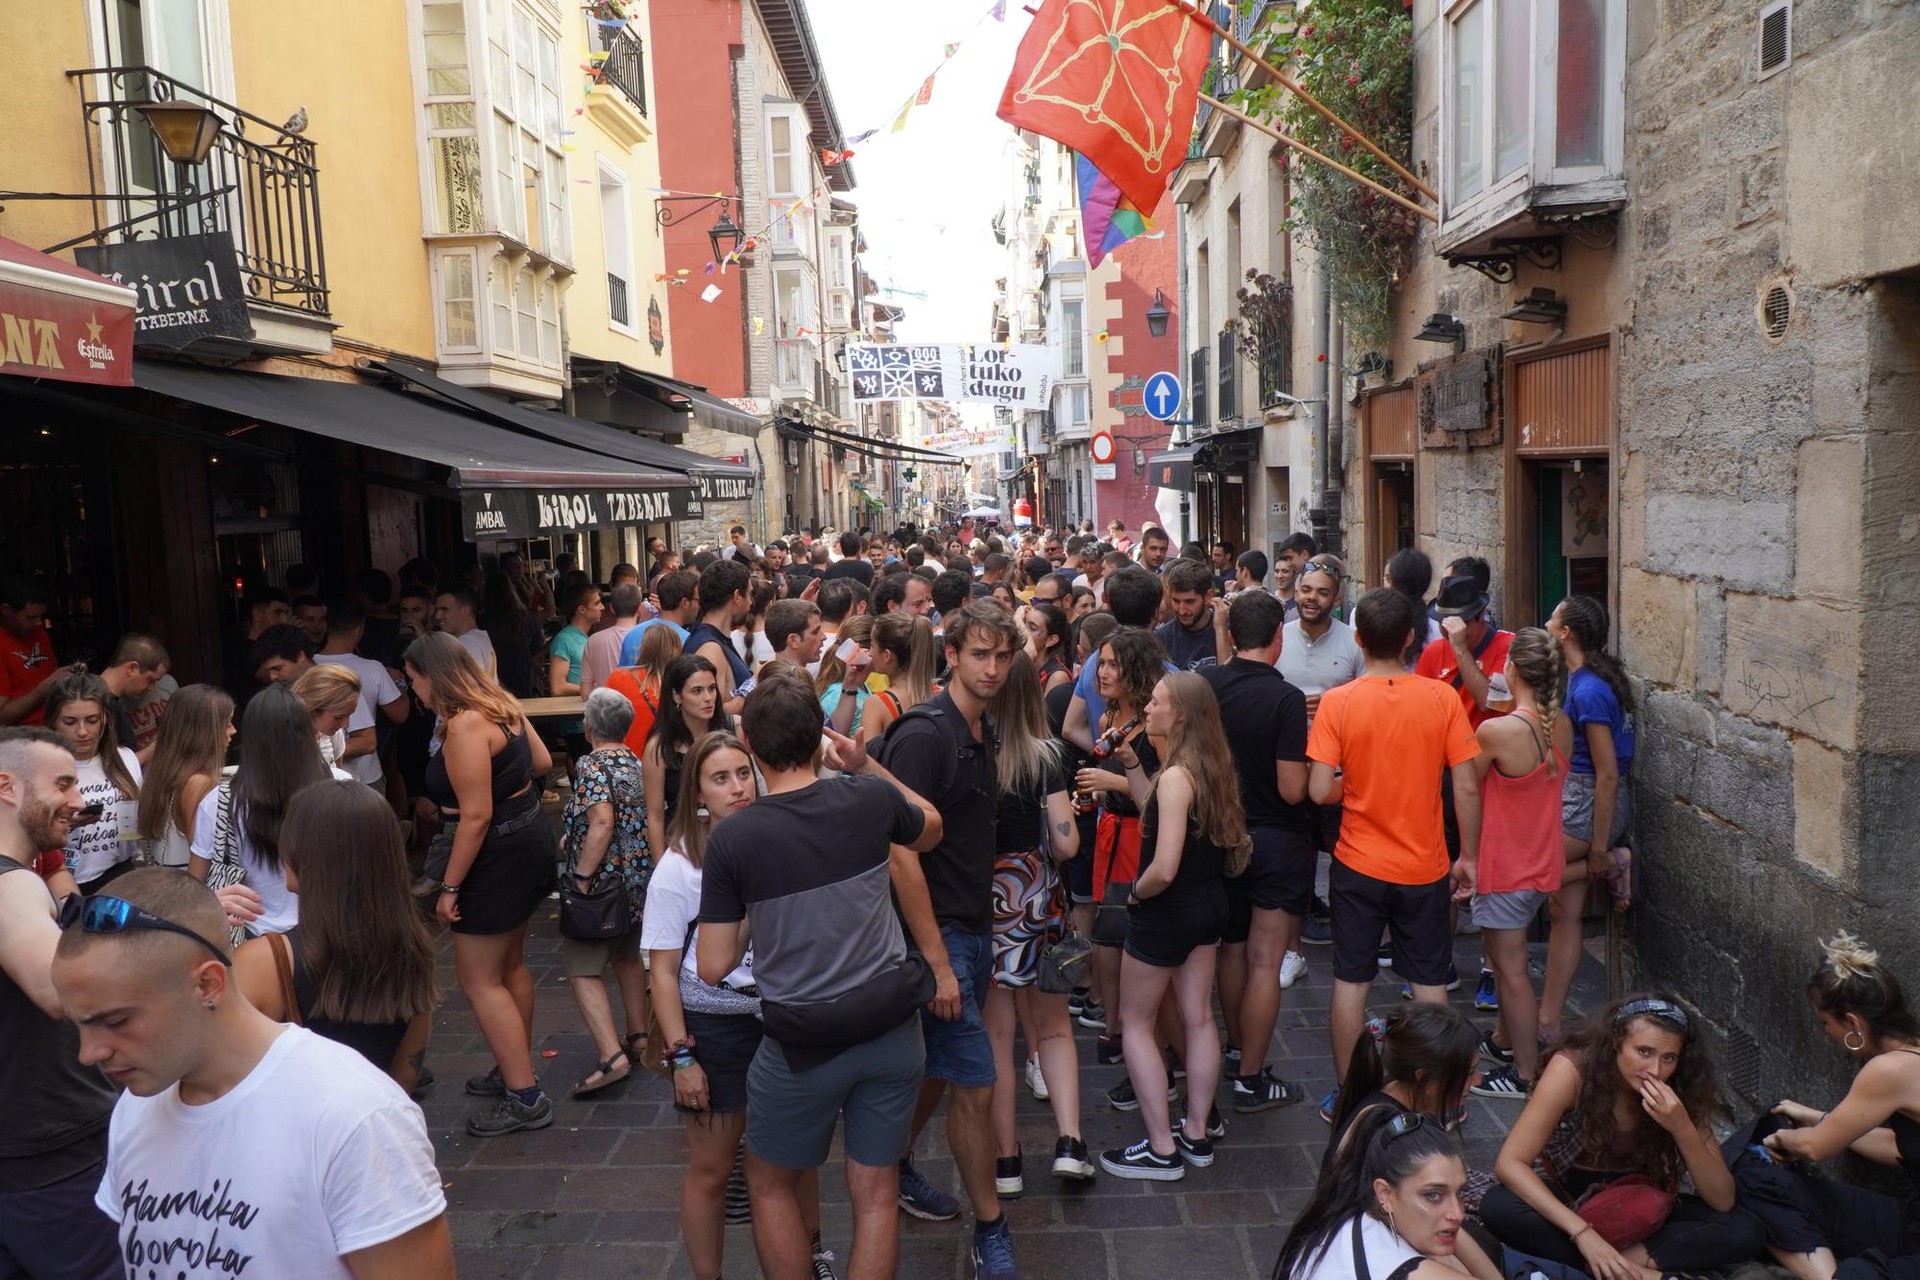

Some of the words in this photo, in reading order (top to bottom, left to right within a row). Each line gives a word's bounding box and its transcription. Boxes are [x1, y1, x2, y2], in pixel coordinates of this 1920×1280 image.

[101, 260, 224, 313] irol
[134, 308, 210, 331] TABERNA
[0, 312, 65, 370] NA
[77, 337, 115, 361] Estrella
[969, 345, 1017, 363] Lor-
[969, 363, 1022, 382] tuko
[969, 380, 1026, 404] dugu
[606, 491, 672, 521] TABERNA
[475, 510, 506, 529] AMBAR
